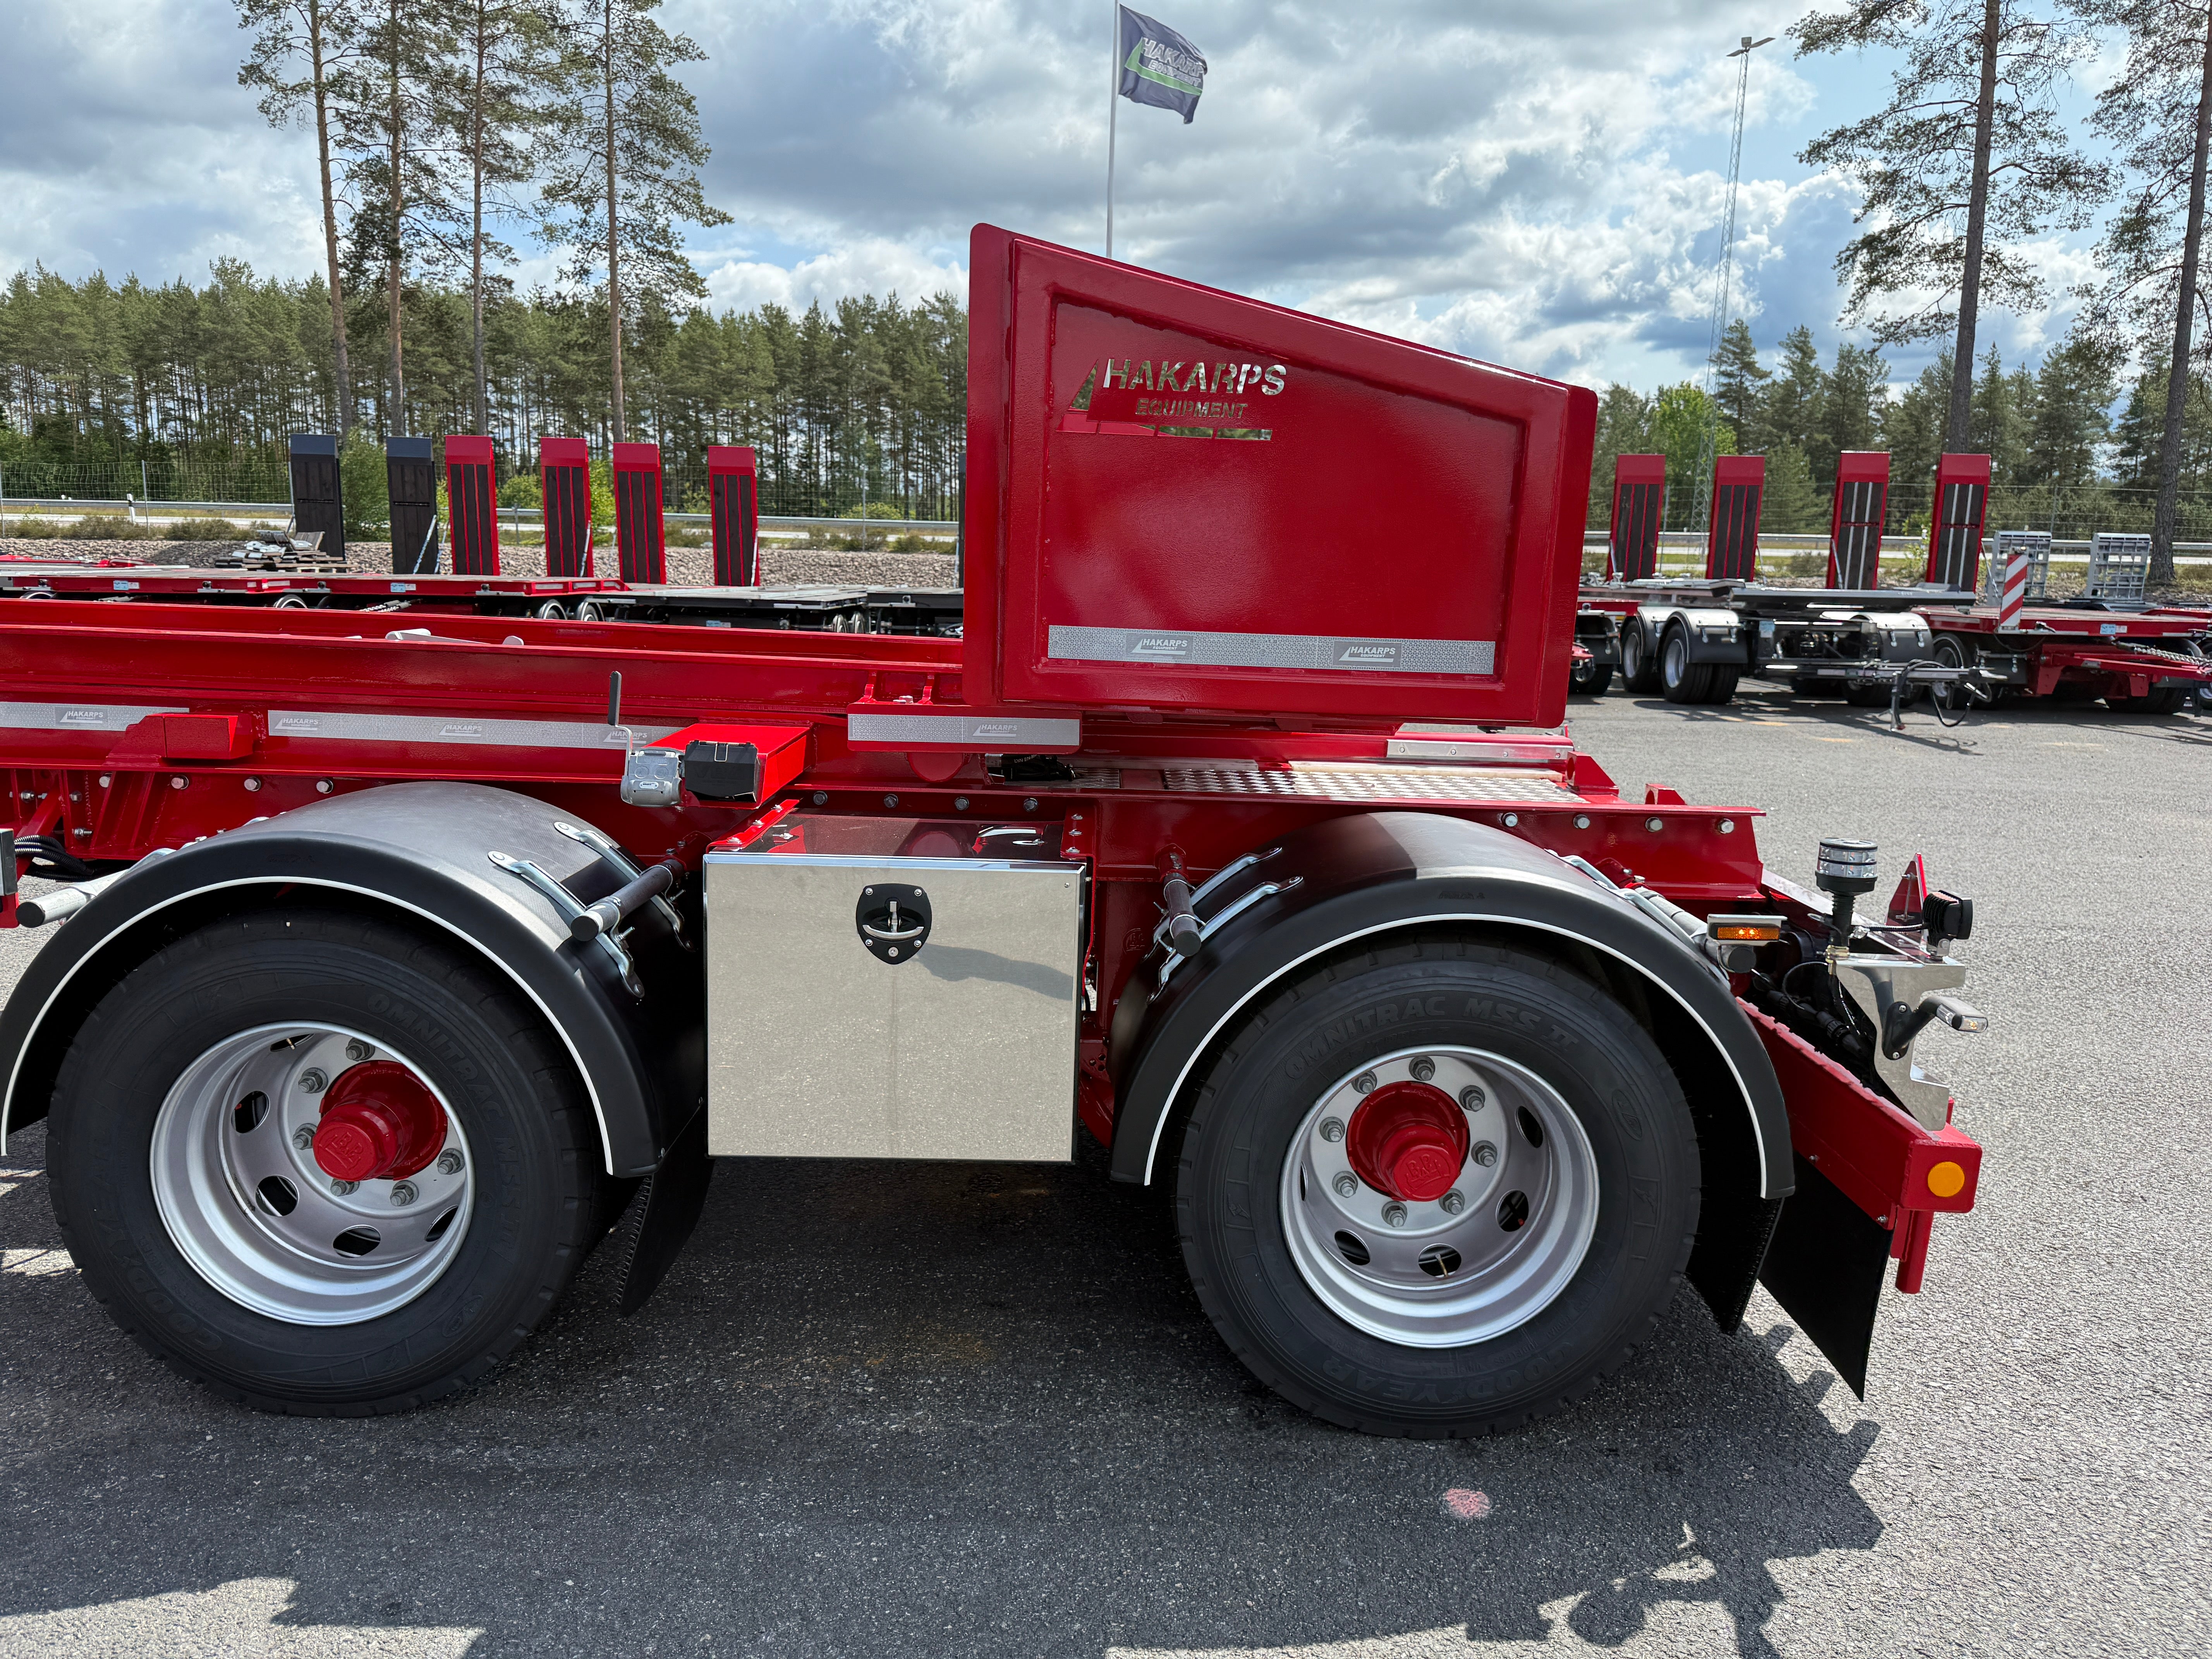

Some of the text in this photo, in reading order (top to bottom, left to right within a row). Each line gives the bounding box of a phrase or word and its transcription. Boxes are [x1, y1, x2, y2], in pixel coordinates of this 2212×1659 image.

[1141, 38, 1204, 77] HAKARP
[1103, 358, 1286, 395] HAKARPS
[1135, 398, 1248, 418] EQUIPMENT
[1142, 639, 1188, 647] HAKARPS
[1350, 646, 1396, 654] HAKARPS
[1284, 996, 1447, 1080] OMNITRAC
[1462, 998, 1542, 1035] MSS
[367, 993, 503, 1122] OMNITRAC
